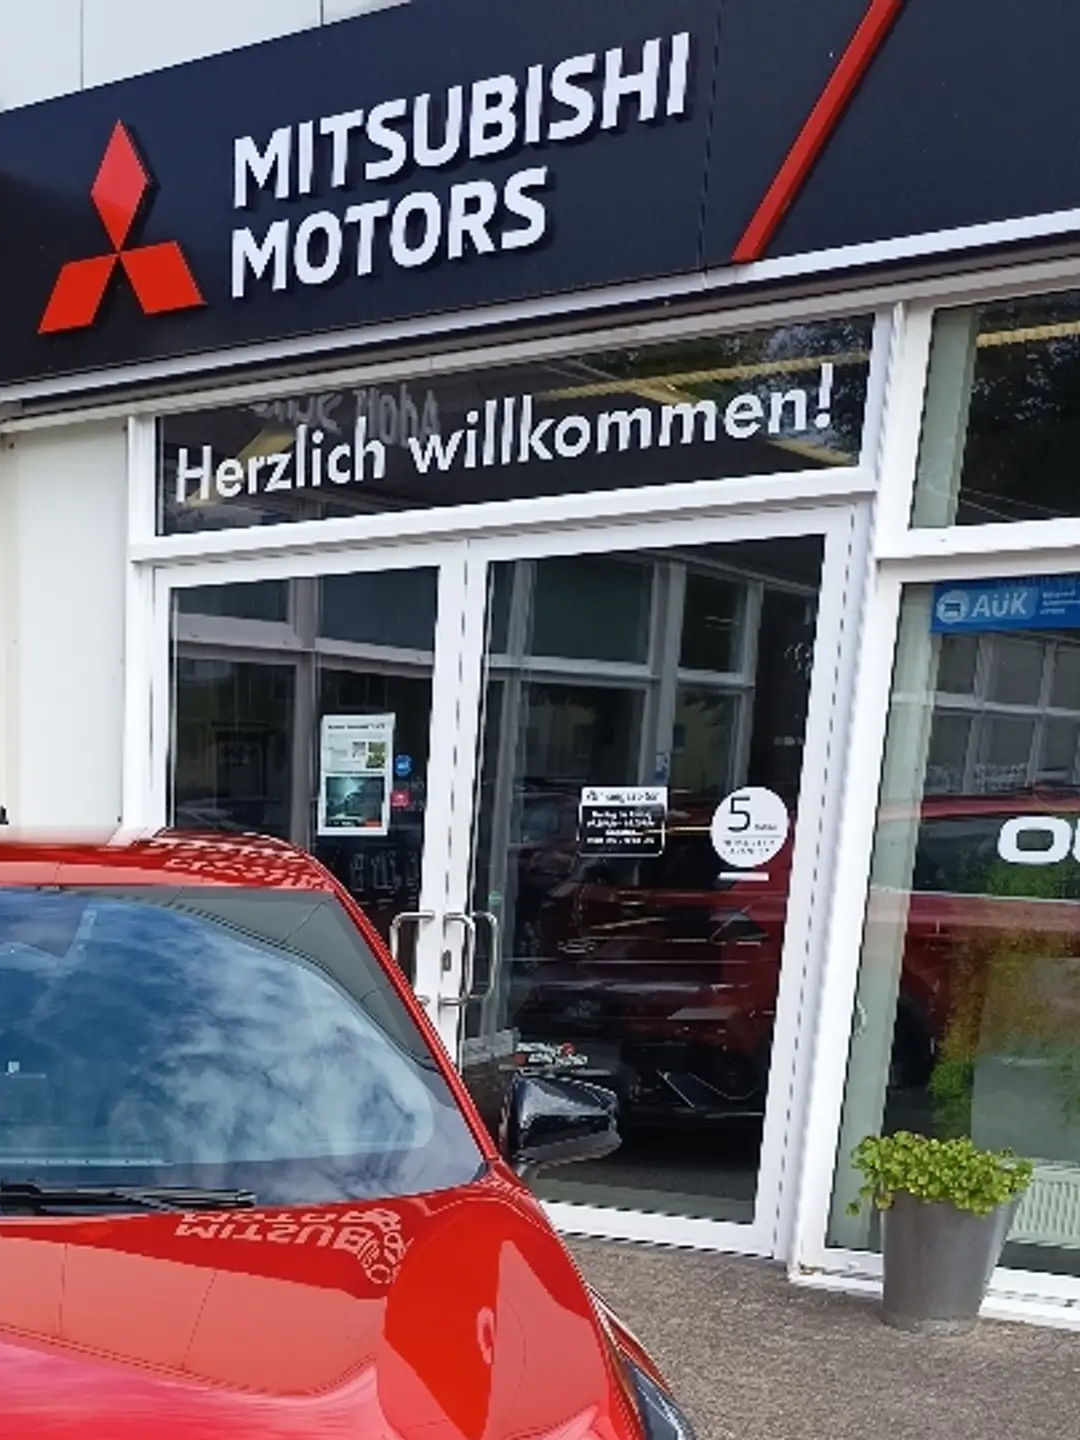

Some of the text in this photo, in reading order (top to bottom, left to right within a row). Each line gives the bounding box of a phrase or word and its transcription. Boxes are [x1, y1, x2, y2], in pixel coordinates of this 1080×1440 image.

[233, 33, 691, 209] MITSUBISHI
[232, 167, 550, 298] MOTORS
[176, 415, 387, 503] Herzlich
[408, 362, 834, 475] willkommen!
[727, 796, 751, 832] 5
[997, 816, 1080, 864] O
